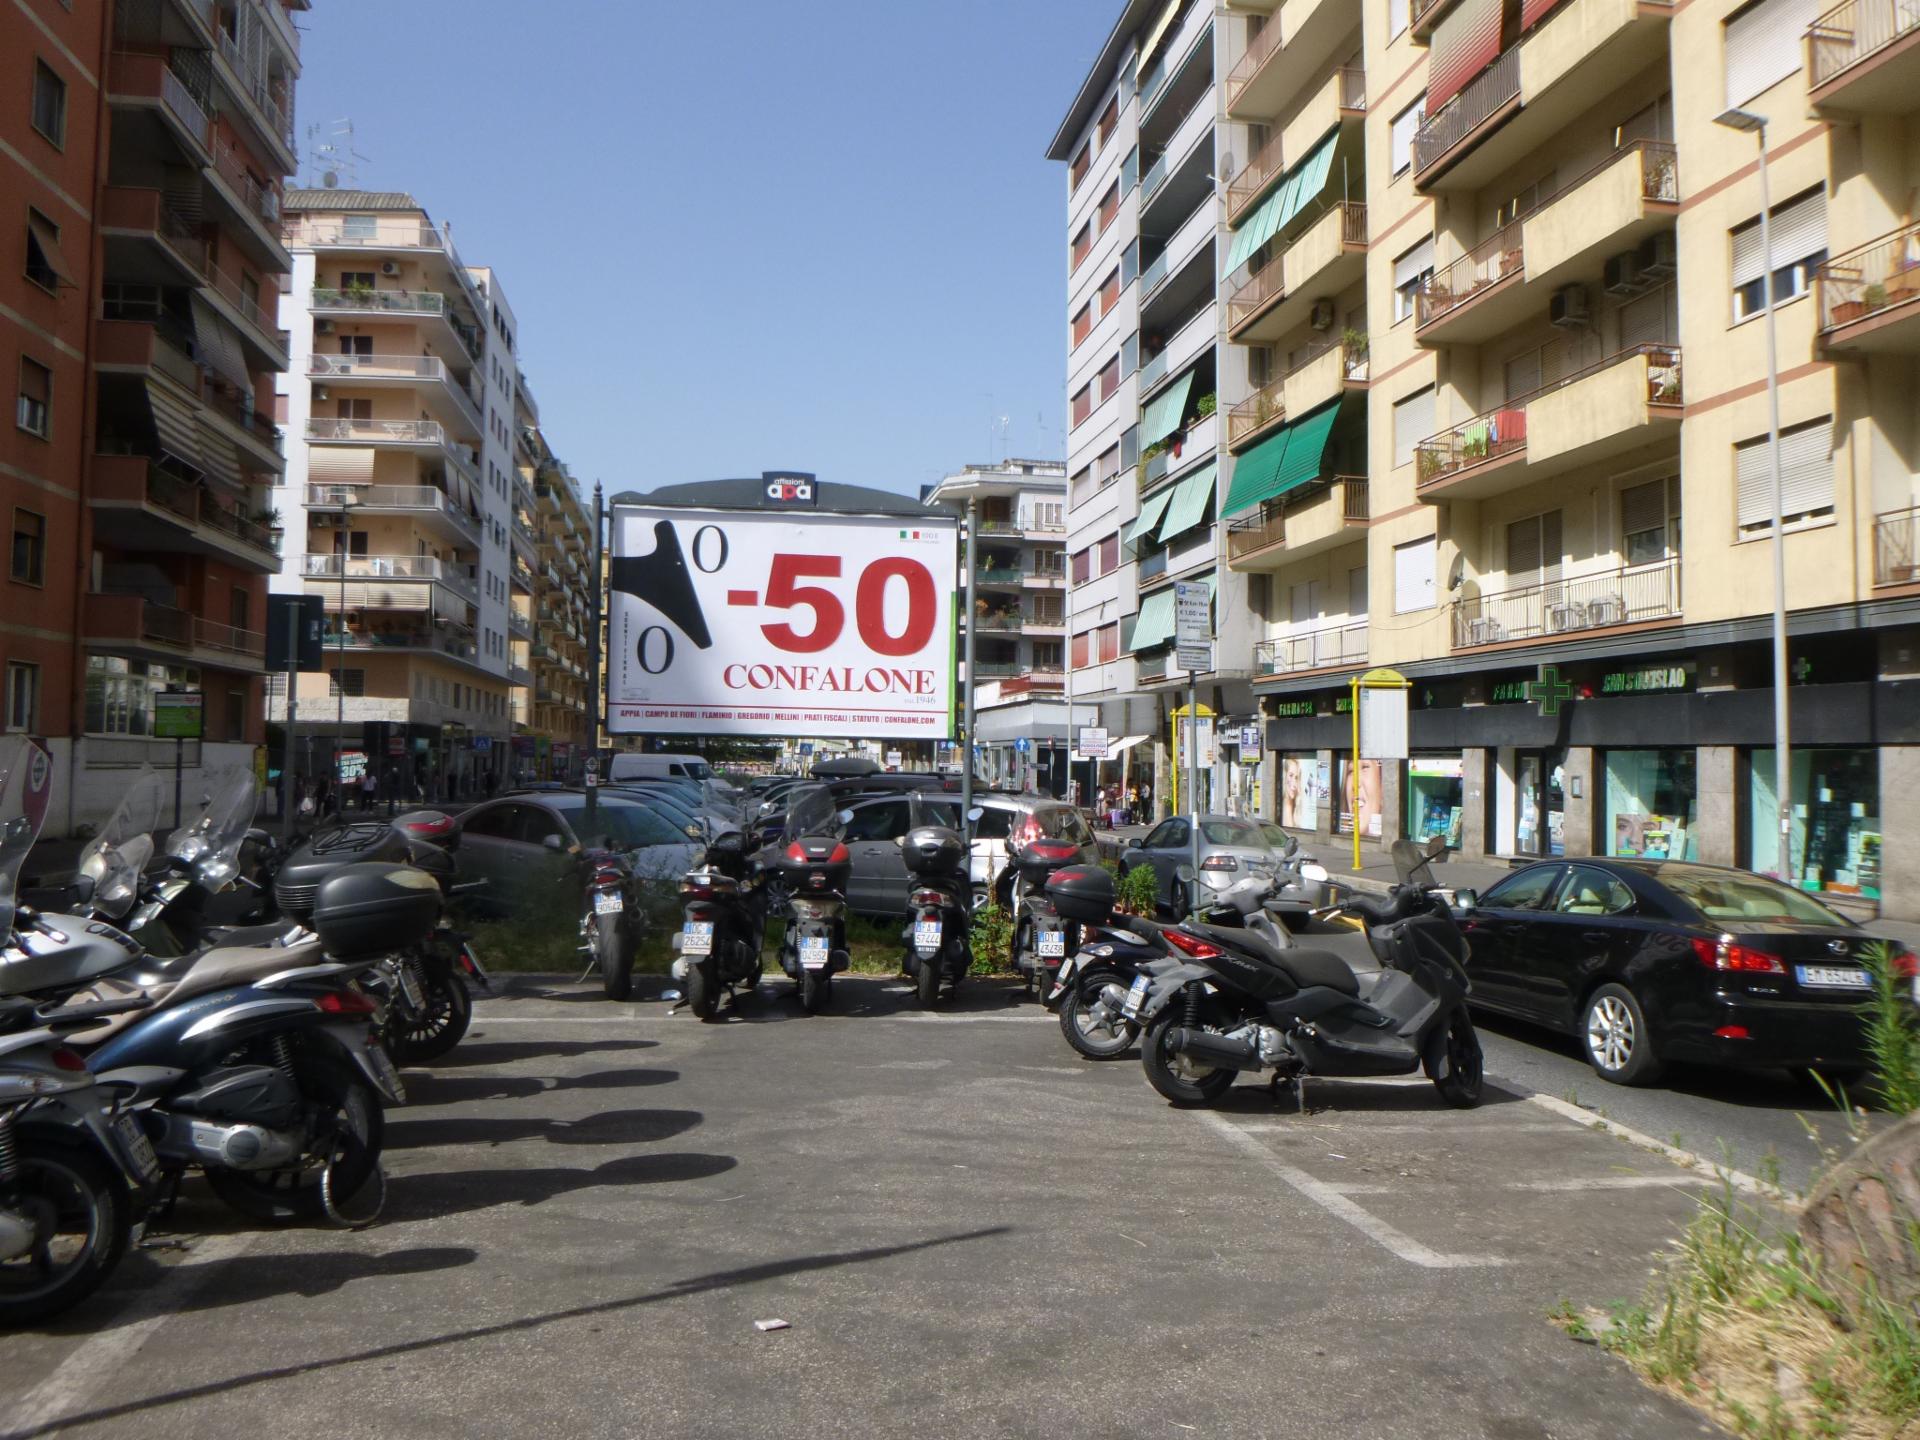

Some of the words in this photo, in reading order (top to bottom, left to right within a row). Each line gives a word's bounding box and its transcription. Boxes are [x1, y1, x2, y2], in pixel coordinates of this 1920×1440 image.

[767, 484, 811, 500] apa
[723, 663, 936, 695] CONFALONE
[915, 694, 936, 705] 1946
[620, 709, 640, 718] APPIA
[645, 710, 669, 718] CAMPO
[670, 710, 678, 718] DE
[679, 710, 697, 719] FIORI
[701, 711, 733, 719] FLAMINIO
[737, 712, 770, 720] GREGORIO
[804, 713, 823, 721] PRATI
[823, 714, 847, 722] FISCALI
[852, 715, 880, 723] STATUTO
[884, 716, 936, 725] CONFALONE.COM
